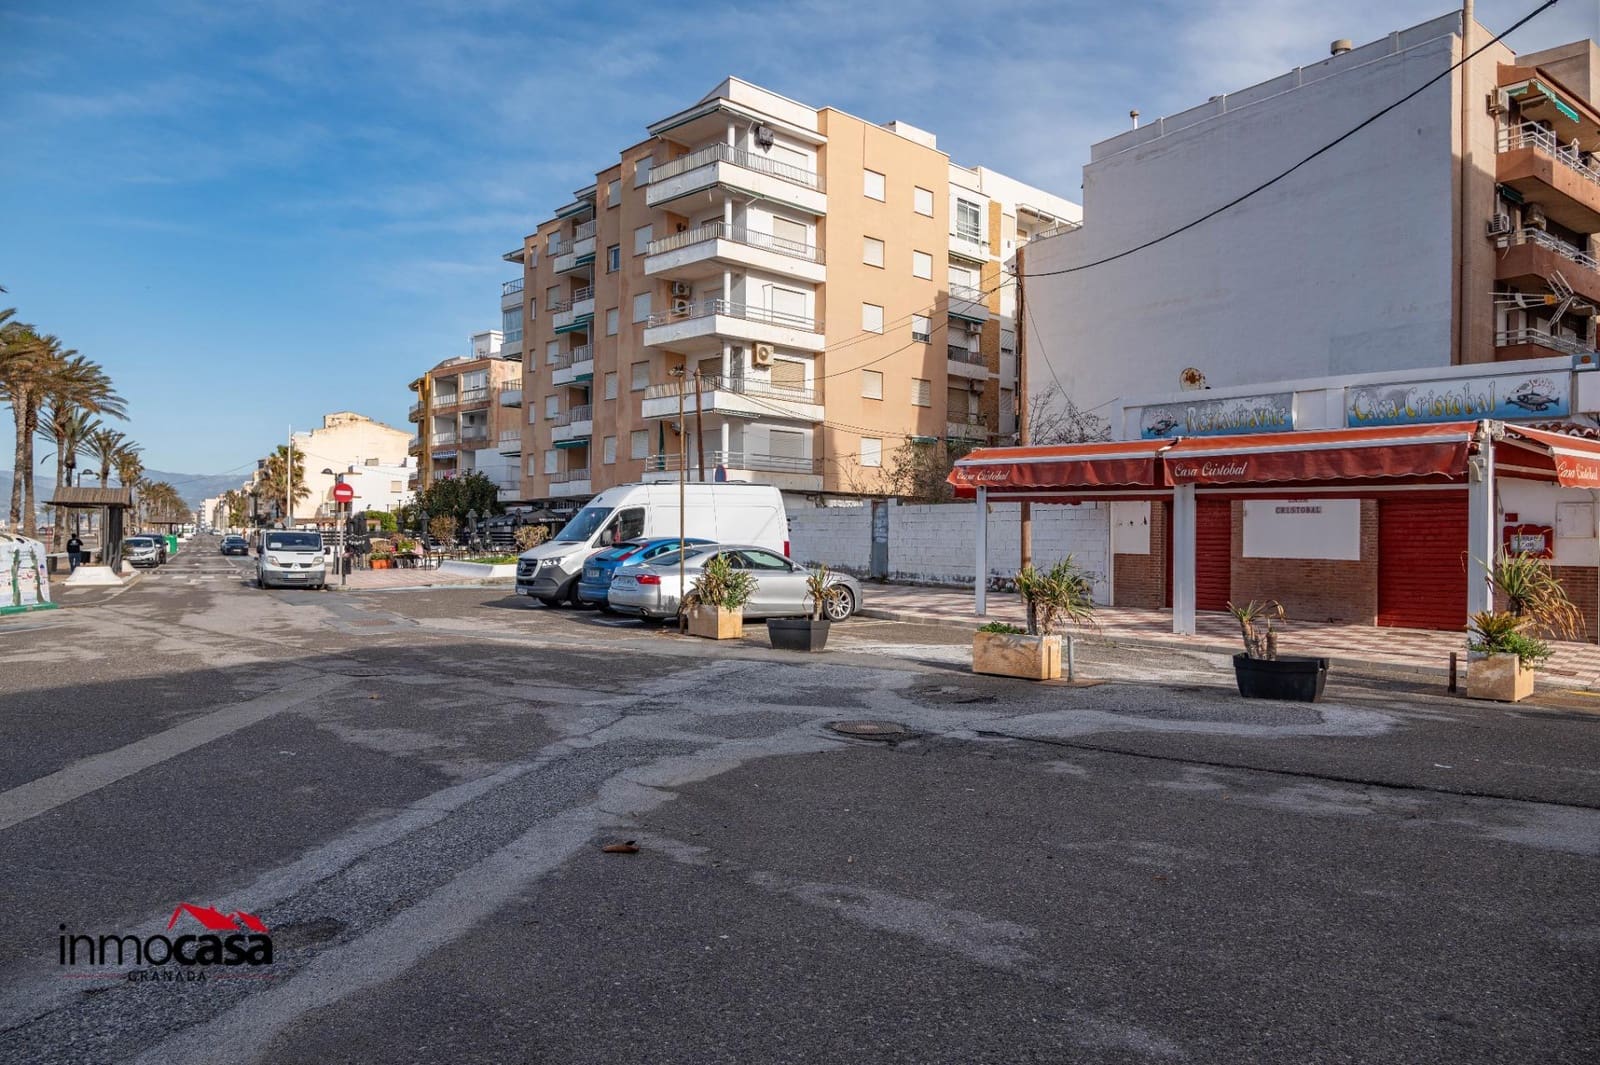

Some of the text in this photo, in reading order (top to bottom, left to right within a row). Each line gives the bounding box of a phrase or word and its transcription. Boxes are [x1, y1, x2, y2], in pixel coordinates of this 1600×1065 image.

[1353, 380, 1496, 420] Casa Cristobal
[1186, 405, 1286, 433] Restaurante
[1174, 463, 1198, 477] Casa
[1275, 506, 1322, 514] CRISTOBAL
